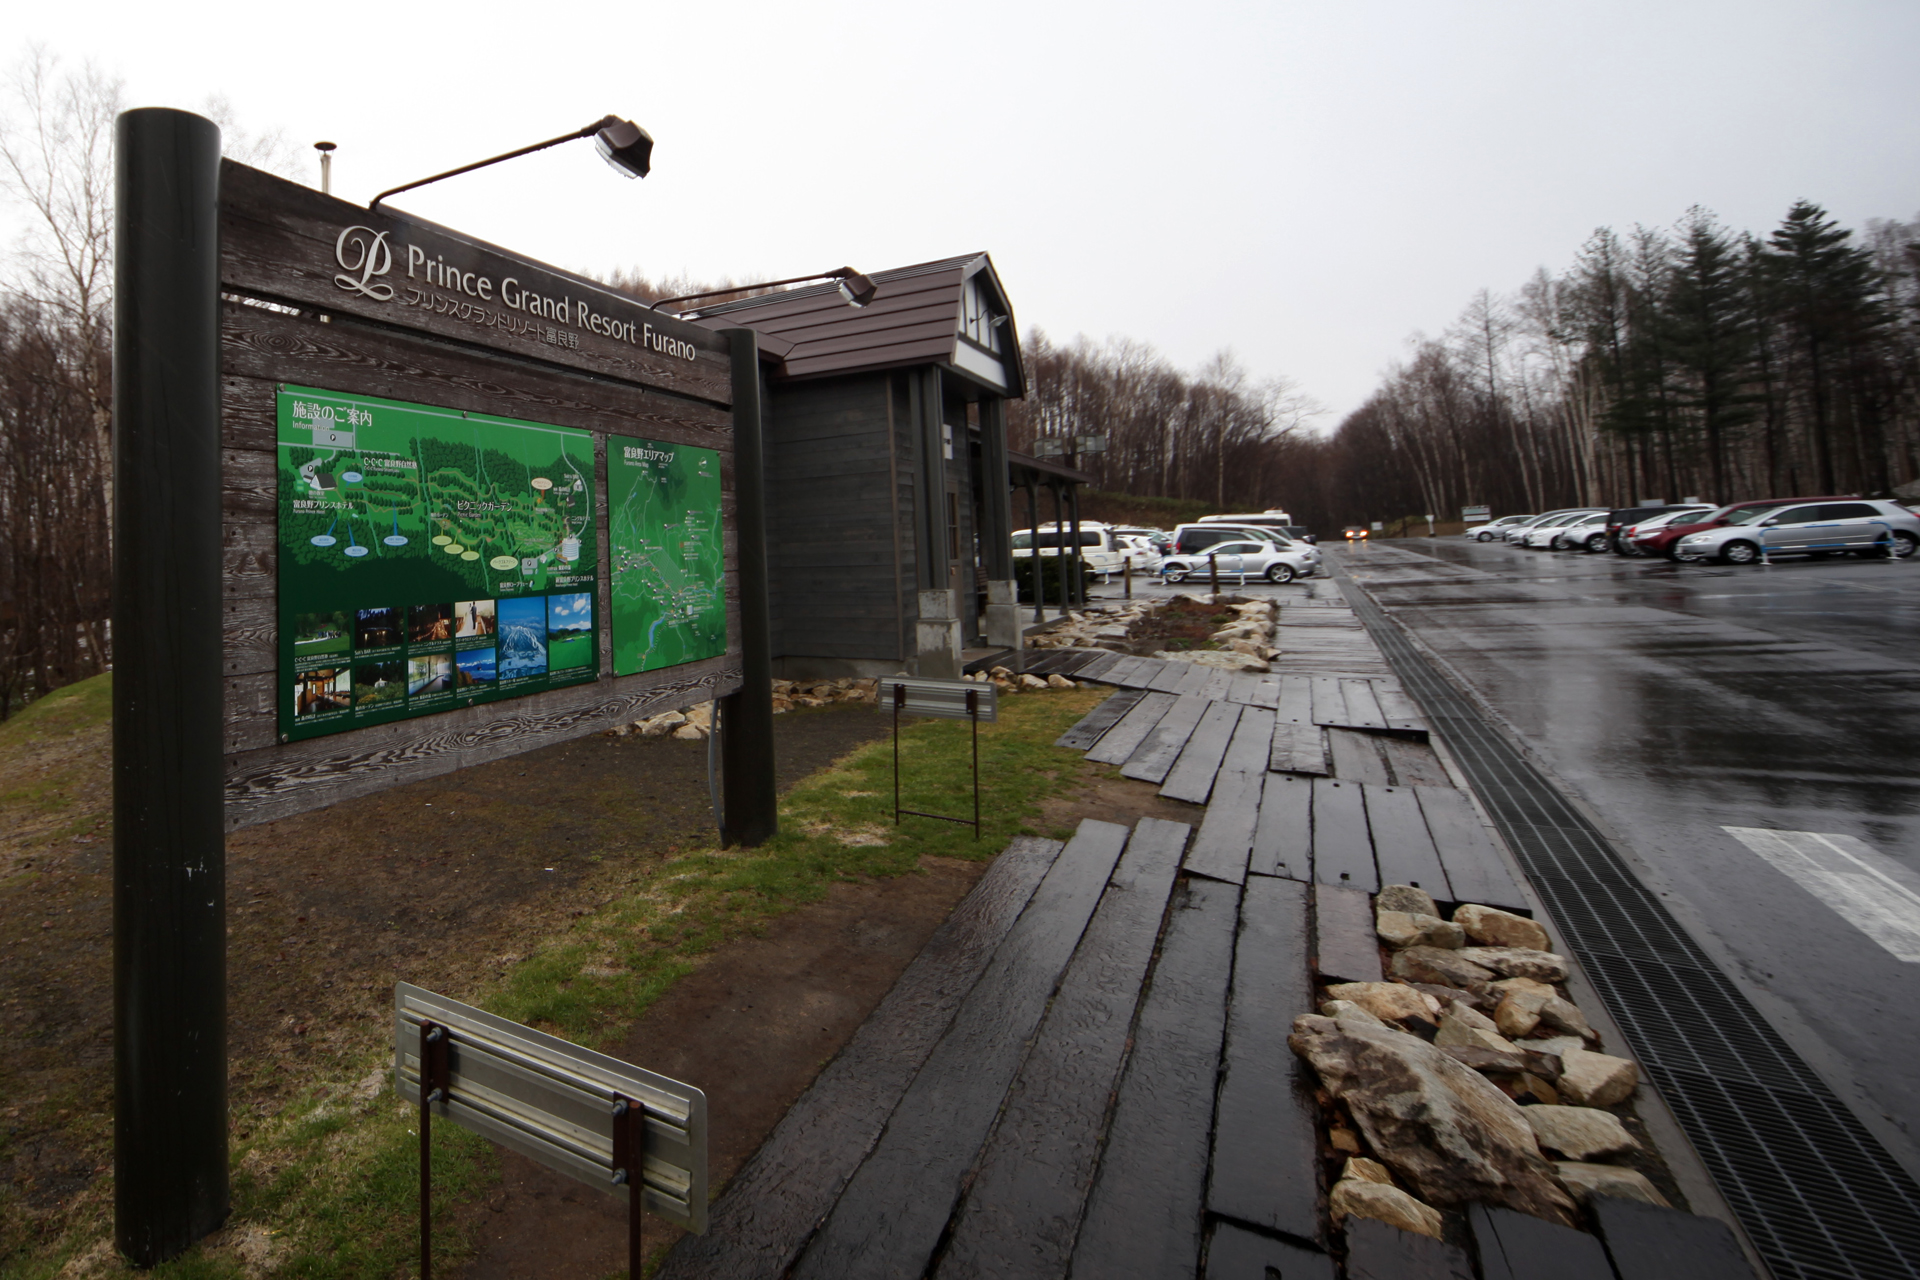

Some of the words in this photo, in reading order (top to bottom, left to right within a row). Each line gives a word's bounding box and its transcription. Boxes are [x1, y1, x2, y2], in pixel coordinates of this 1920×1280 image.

[406, 243, 493, 302] Prince
[501, 276, 570, 325] Grand
[576, 300, 637, 345] Resort
[642, 322, 697, 362] Furano
[406, 286, 581, 351] プリンスグランドリゾート富良野
[292, 400, 373, 427] 施設のご案内
[292, 420, 331, 432] Information
[623, 445, 676, 464] 富良野エリアマップ
[293, 499, 355, 511] 富良野プリンスホテル
[457, 499, 513, 512] ピクニックガーデン
